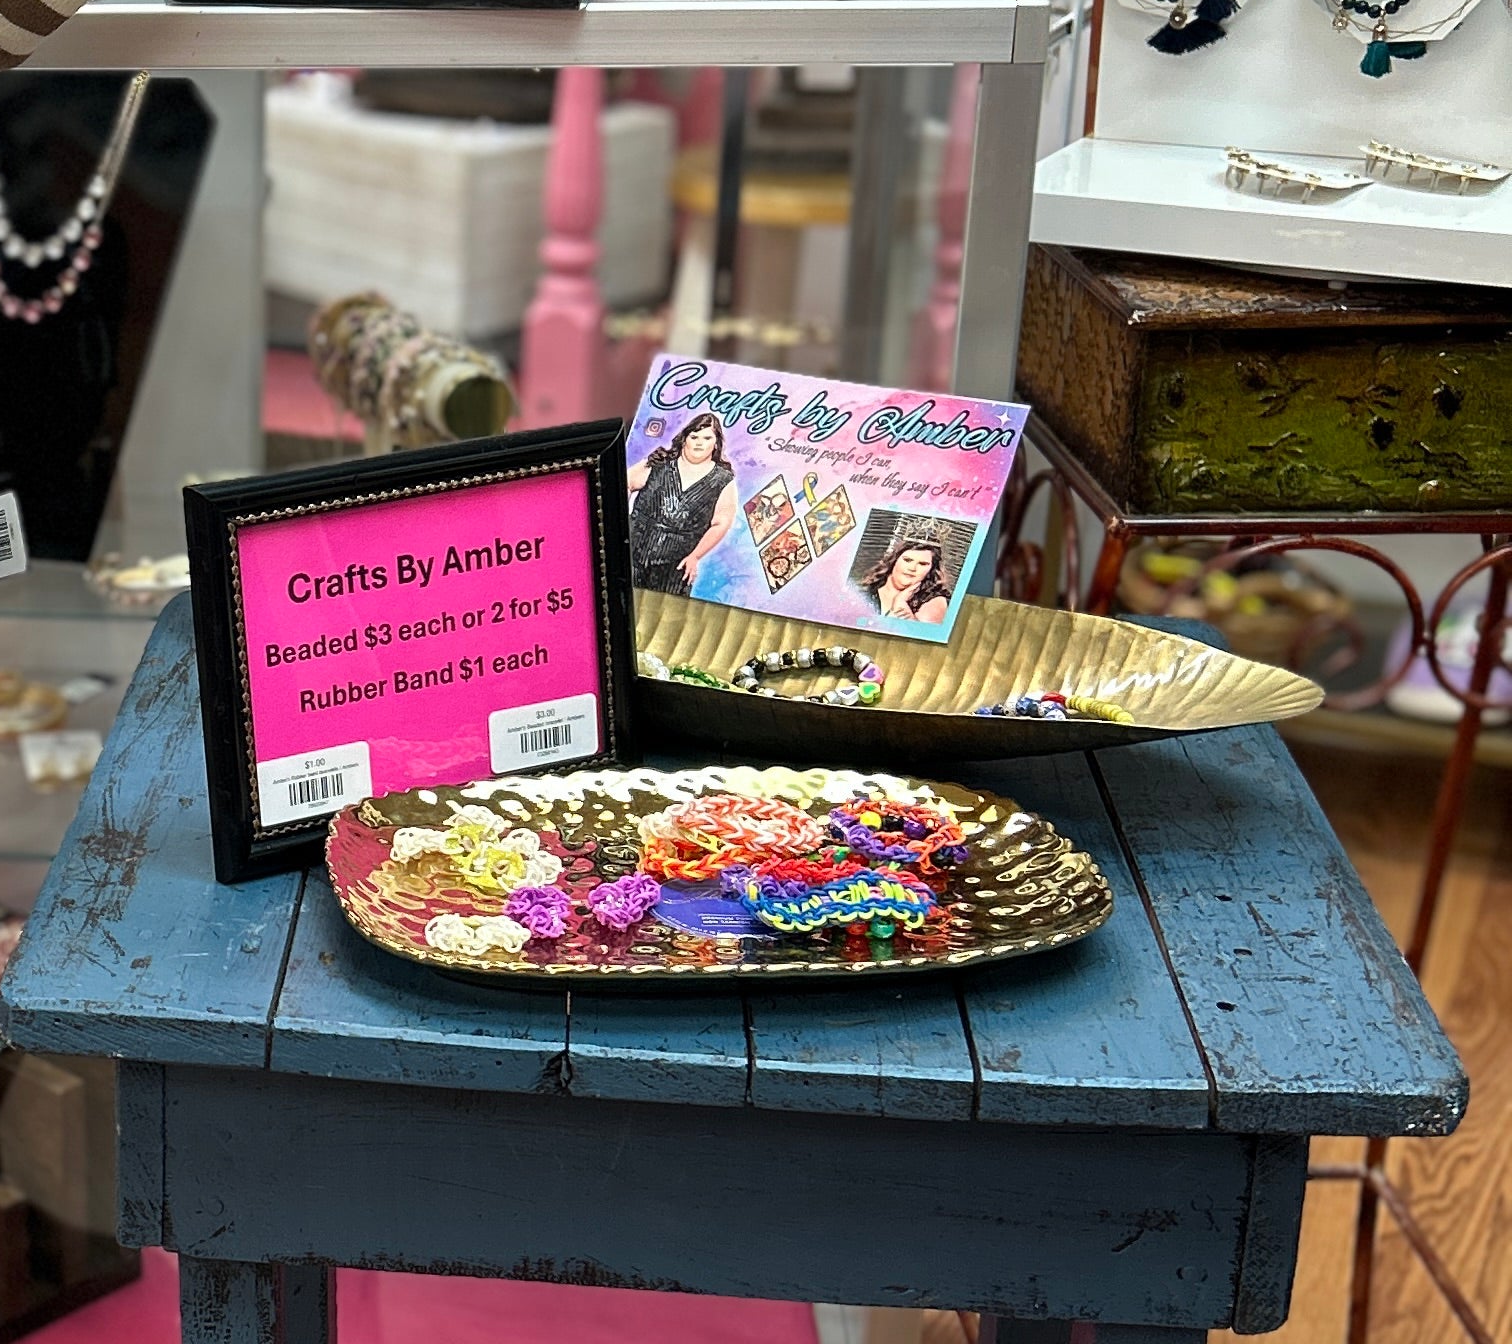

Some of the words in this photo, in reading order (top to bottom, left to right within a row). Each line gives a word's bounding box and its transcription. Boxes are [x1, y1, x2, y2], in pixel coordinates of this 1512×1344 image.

[650, 362, 791, 435] Crafts
[791, 390, 852, 442] by
[857, 399, 1013, 454] Amber
[818, 447, 855, 468] people
[856, 452, 873, 466] I
[871, 456, 892, 470] can,
[849, 467, 881, 485] when
[881, 472, 907, 493] they
[907, 482, 930, 500] say
[931, 481, 949, 497] I
[287, 562, 388, 604] Crafts
[397, 553, 435, 588] By
[441, 534, 546, 577] Amber
[265, 628, 358, 668] Beaded
[364, 622, 393, 651] $3
[398, 610, 457, 643] each
[462, 608, 487, 630] or
[490, 601, 505, 624] 2
[508, 595, 543, 621] for
[546, 586, 575, 616] $5
[299, 676, 388, 713] Rubber
[393, 661, 454, 695] Band
[459, 655, 485, 682] $1
[491, 643, 549, 675] each
[304, 757, 326, 770] $1.00
